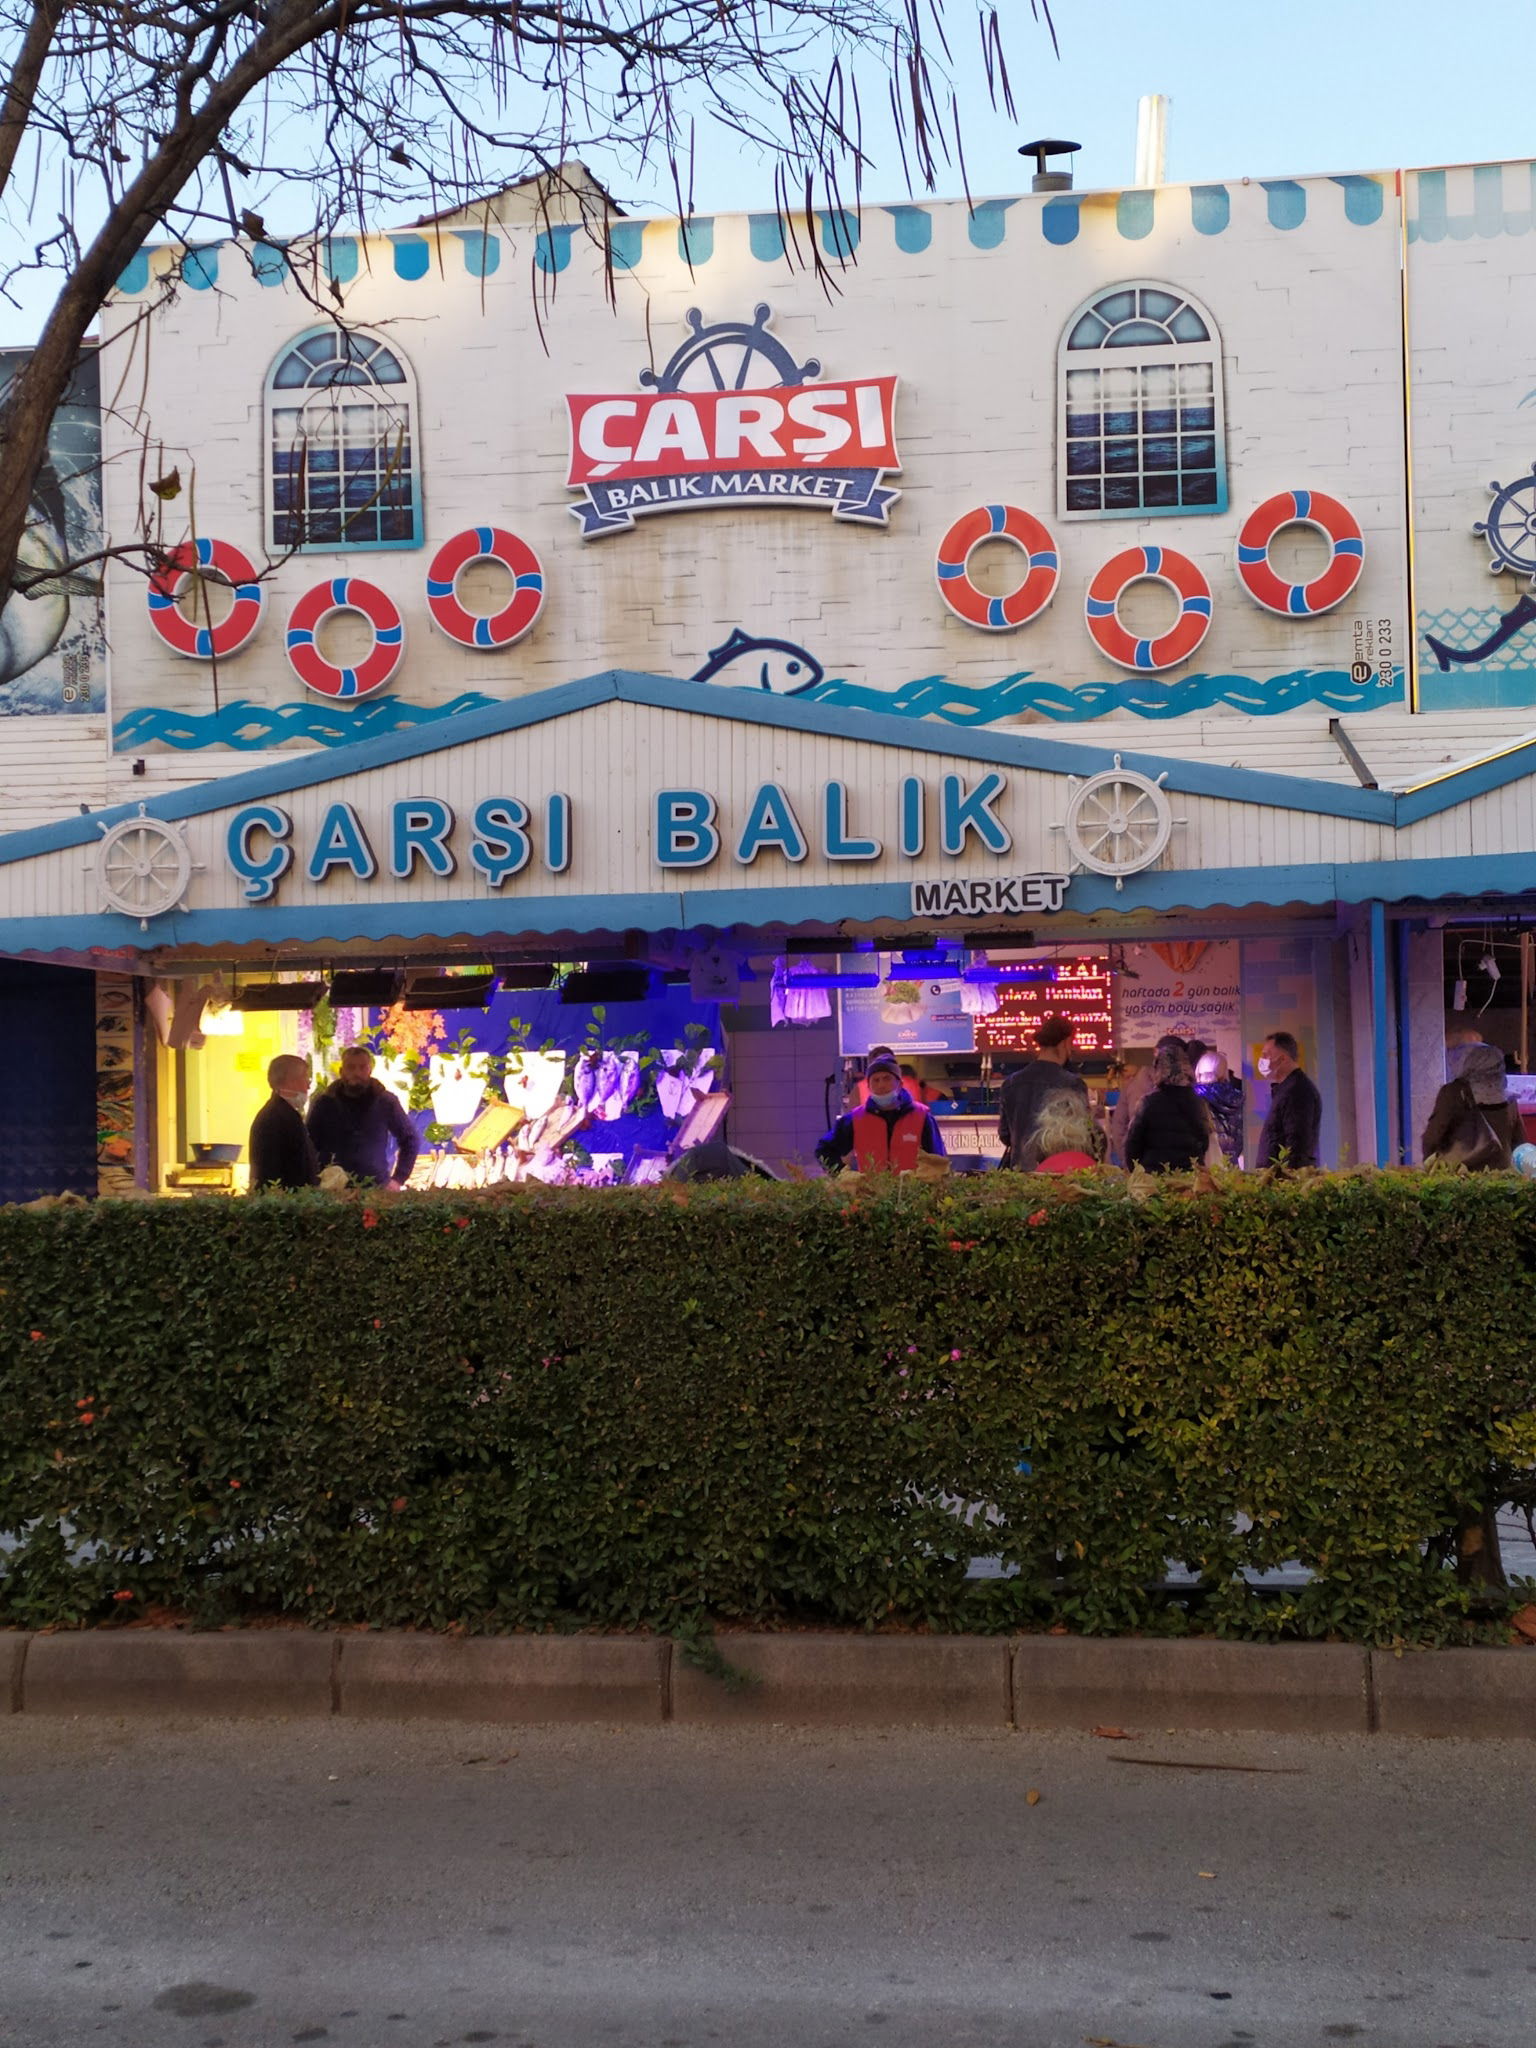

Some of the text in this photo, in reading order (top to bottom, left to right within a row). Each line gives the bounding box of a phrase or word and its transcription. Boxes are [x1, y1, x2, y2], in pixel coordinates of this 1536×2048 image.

[578, 385, 887, 477] ÇARŞI
[607, 473, 855, 510] BALIK MARKET
[1352, 620, 1364, 661] emta
[1365, 620, 1374, 661] reklam
[1378, 619, 1393, 687] 230 0 233
[226, 769, 1012, 901] ÇARŞI BALIK
[913, 876, 1067, 914] MARKET
[1122, 987, 1170, 998] haftada
[1172, 981, 1185, 998] 2
[1187, 986, 1210, 1000] gün
[1125, 1004, 1166, 1017] yaşam
[1168, 1003, 1198, 1017] boyu
[1200, 1001, 1235, 1015] sağlık
